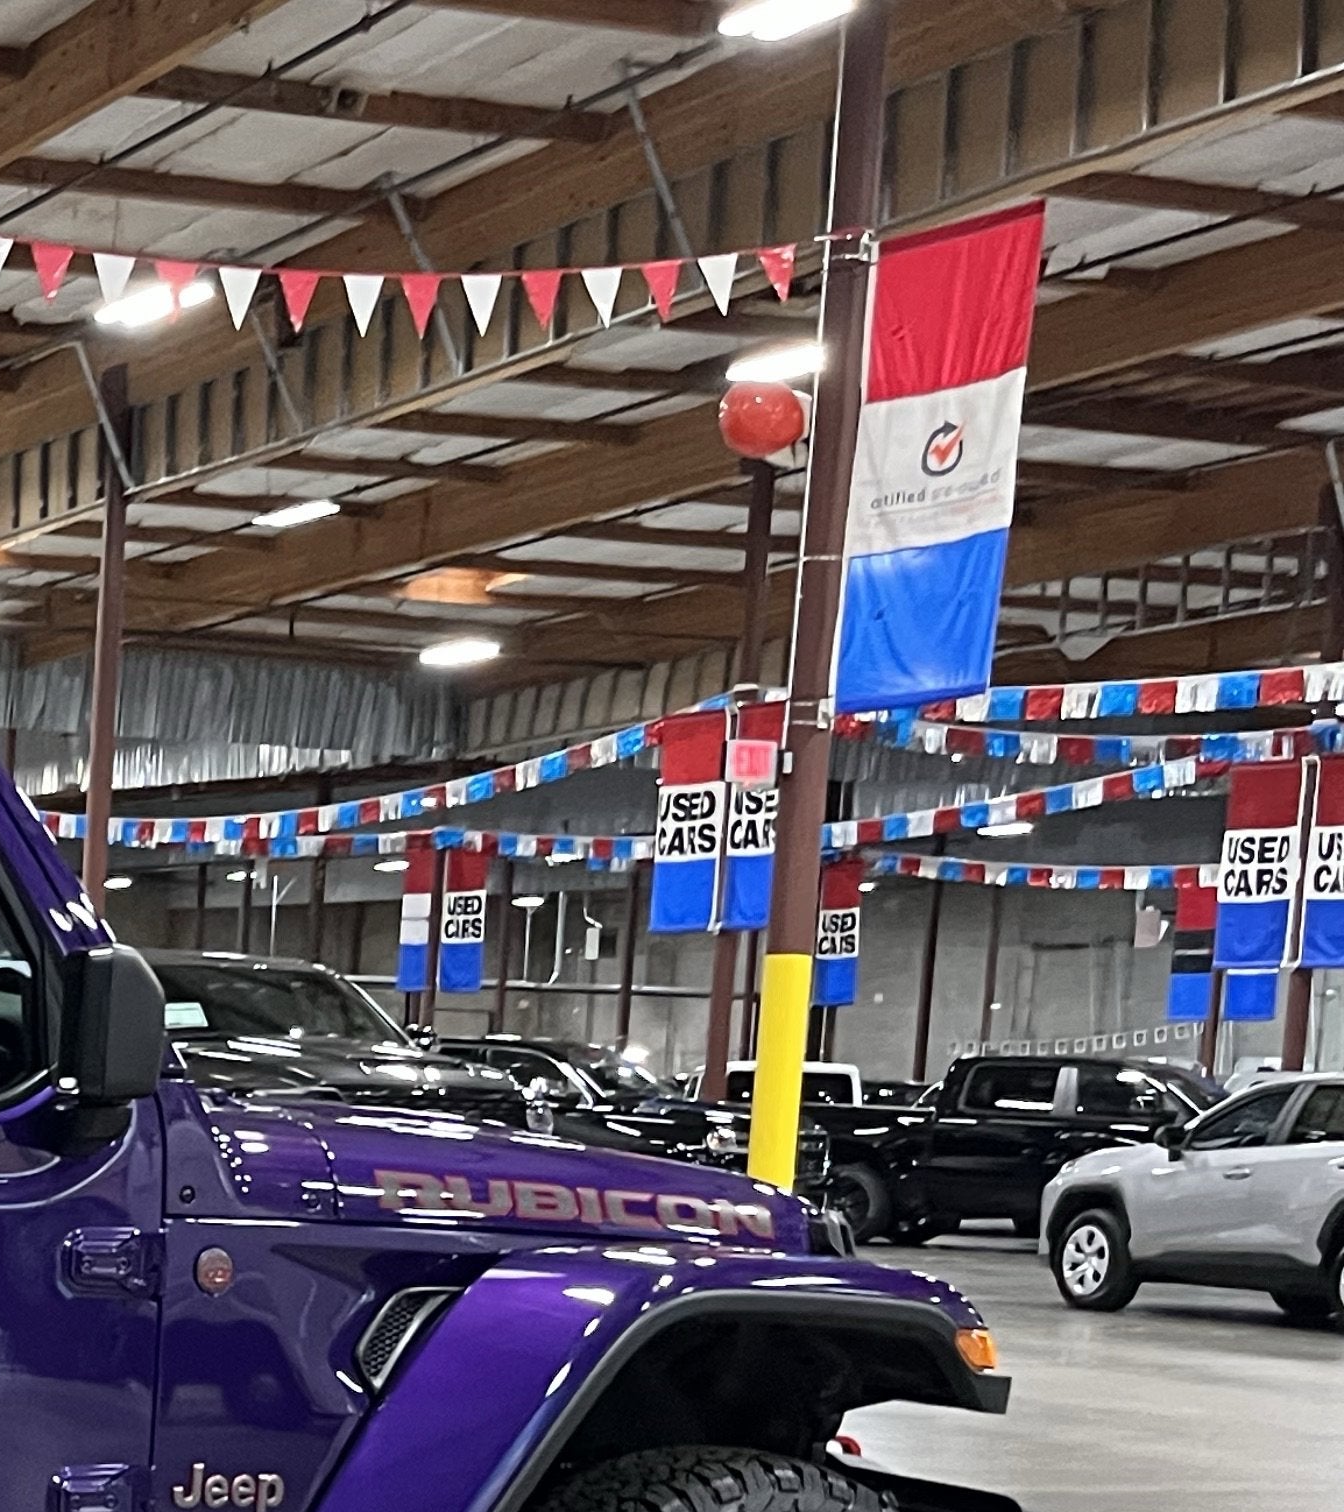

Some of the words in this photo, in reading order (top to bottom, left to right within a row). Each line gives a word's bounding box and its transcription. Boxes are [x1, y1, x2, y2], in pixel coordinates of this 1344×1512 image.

[660, 790, 716, 822] USED
[733, 789, 778, 815] USE
[657, 824, 717, 856] CARS
[729, 819, 774, 849] CAR
[1228, 835, 1290, 864] USED
[1223, 866, 1288, 896] CARS
[448, 895, 483, 916] USED
[821, 913, 857, 934] USED
[374, 1169, 775, 1240] RUBICON
